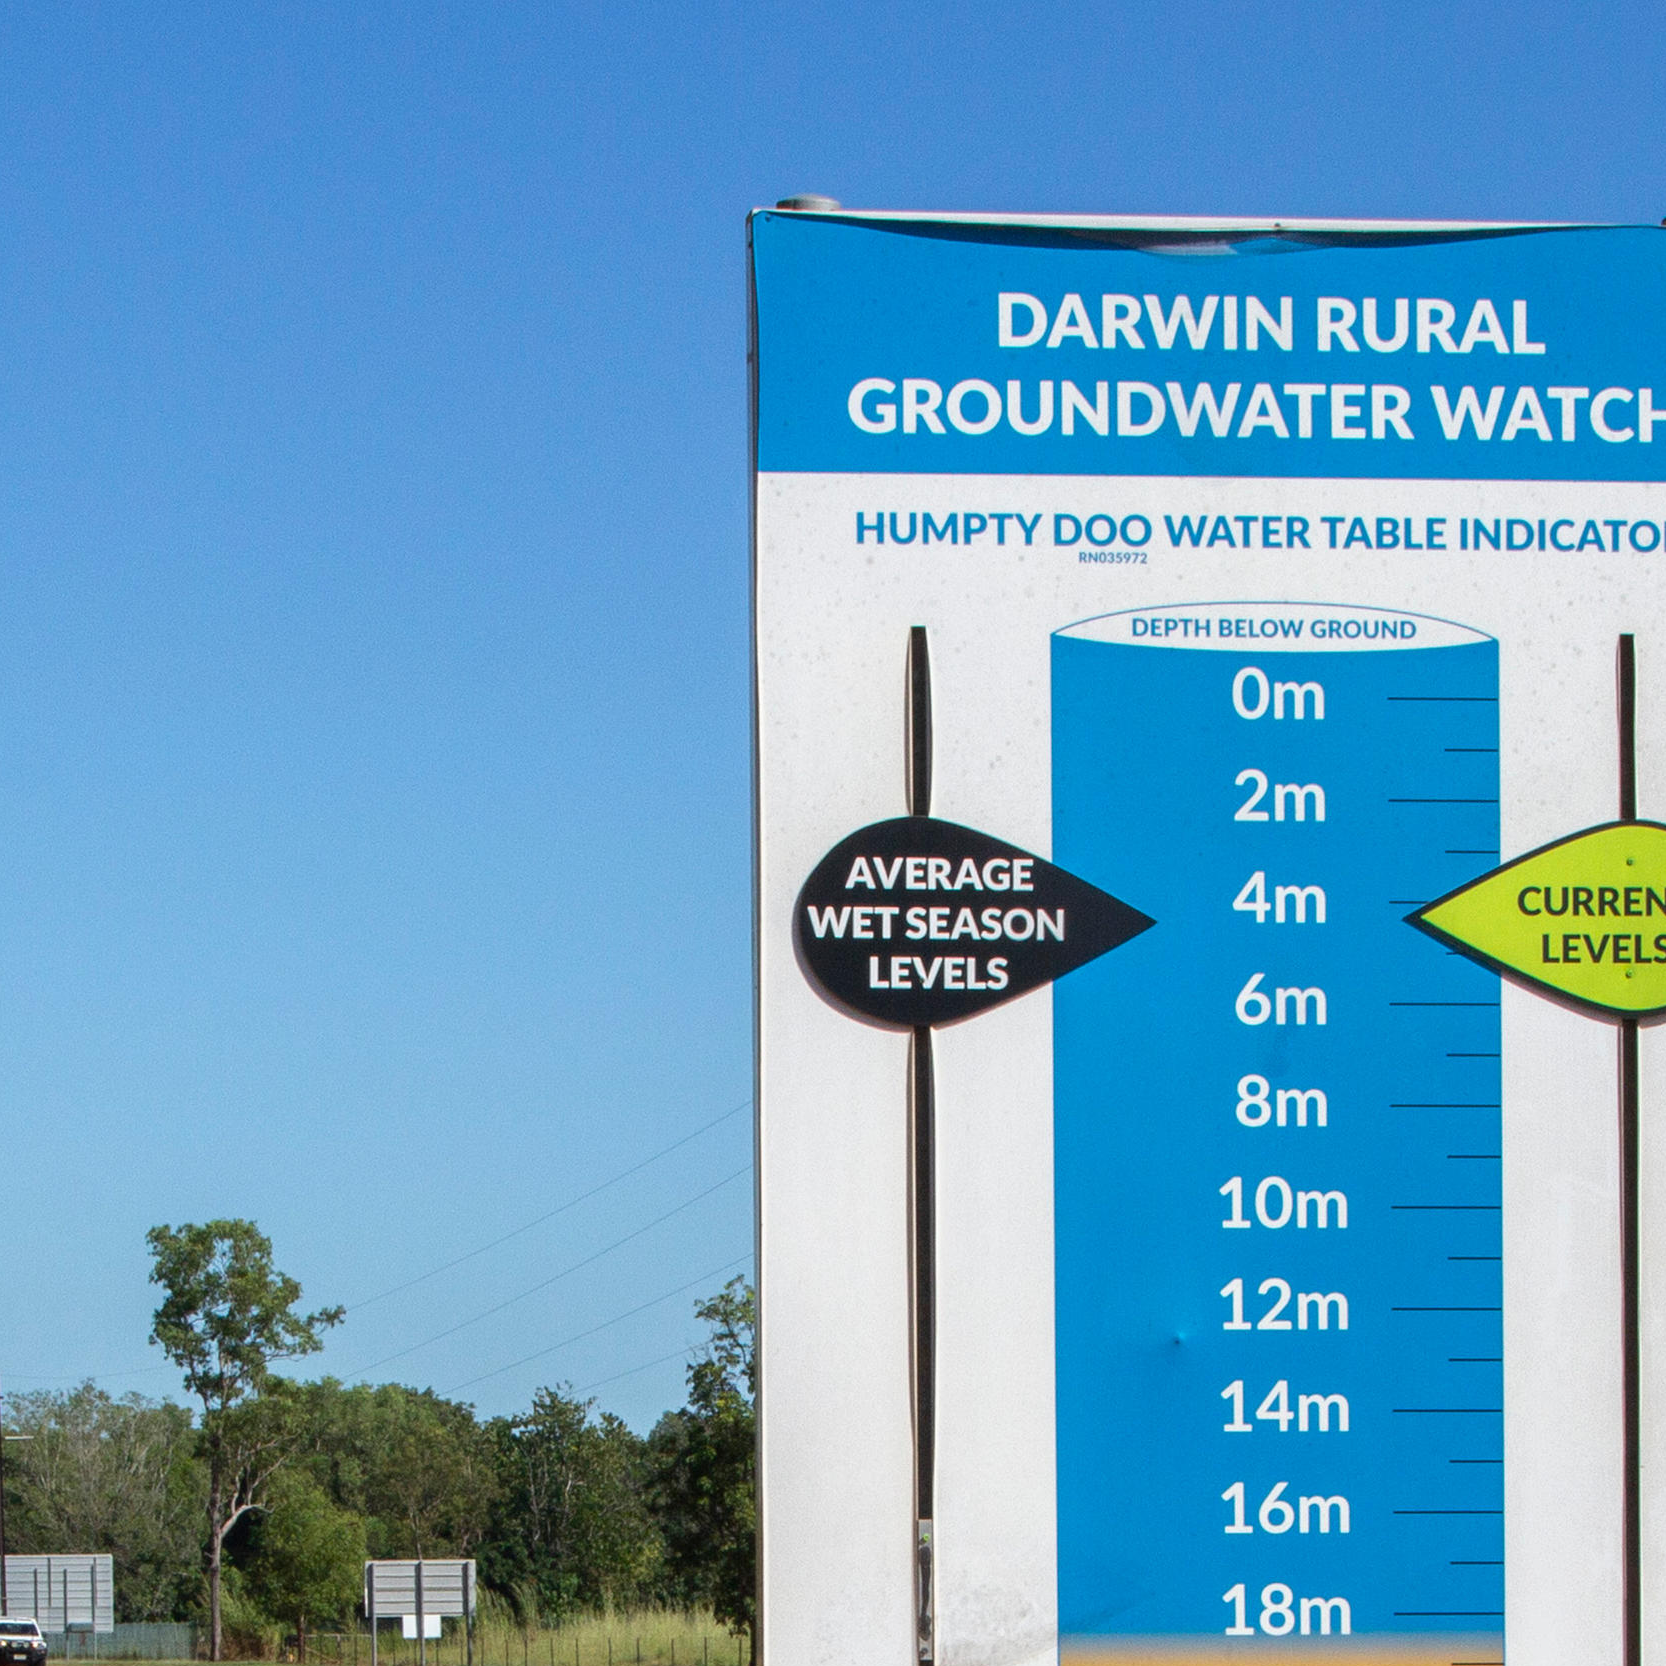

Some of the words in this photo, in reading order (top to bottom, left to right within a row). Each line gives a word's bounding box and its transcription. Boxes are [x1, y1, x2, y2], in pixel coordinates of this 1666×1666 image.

[998, 292, 1293, 351] DARWIN
[1317, 297, 1546, 354] RURAL
[847, 377, 1415, 439] GROUNDWATER
[856, 511, 1043, 545] HUMPTY
[1053, 512, 1153, 547] DOO
[1163, 514, 1311, 549] WATER
[1320, 515, 1447, 550] TABLE
[1078, 551, 1148, 564] RN035972
[1132, 617, 1211, 637] DEPTH
[1218, 618, 1304, 638] BELOW
[1310, 619, 1417, 639] GROUND
[1232, 666, 1325, 720] 0m
[1234, 768, 1326, 821] 2m
[845, 856, 1034, 891] AVERAGE
[1232, 870, 1326, 923] 4m
[807, 905, 900, 939] WET
[905, 907, 1065, 941] SEASON
[869, 956, 1009, 989] LEVELS
[1235, 972, 1327, 1025] 6m
[1236, 1074, 1327, 1127] 8m
[1219, 1176, 1348, 1229] 10m
[1220, 1277, 1349, 1330] 12m
[1220, 1380, 1349, 1432] 14m
[1221, 1481, 1350, 1534] 16m
[1222, 1582, 1351, 1636] 18m
